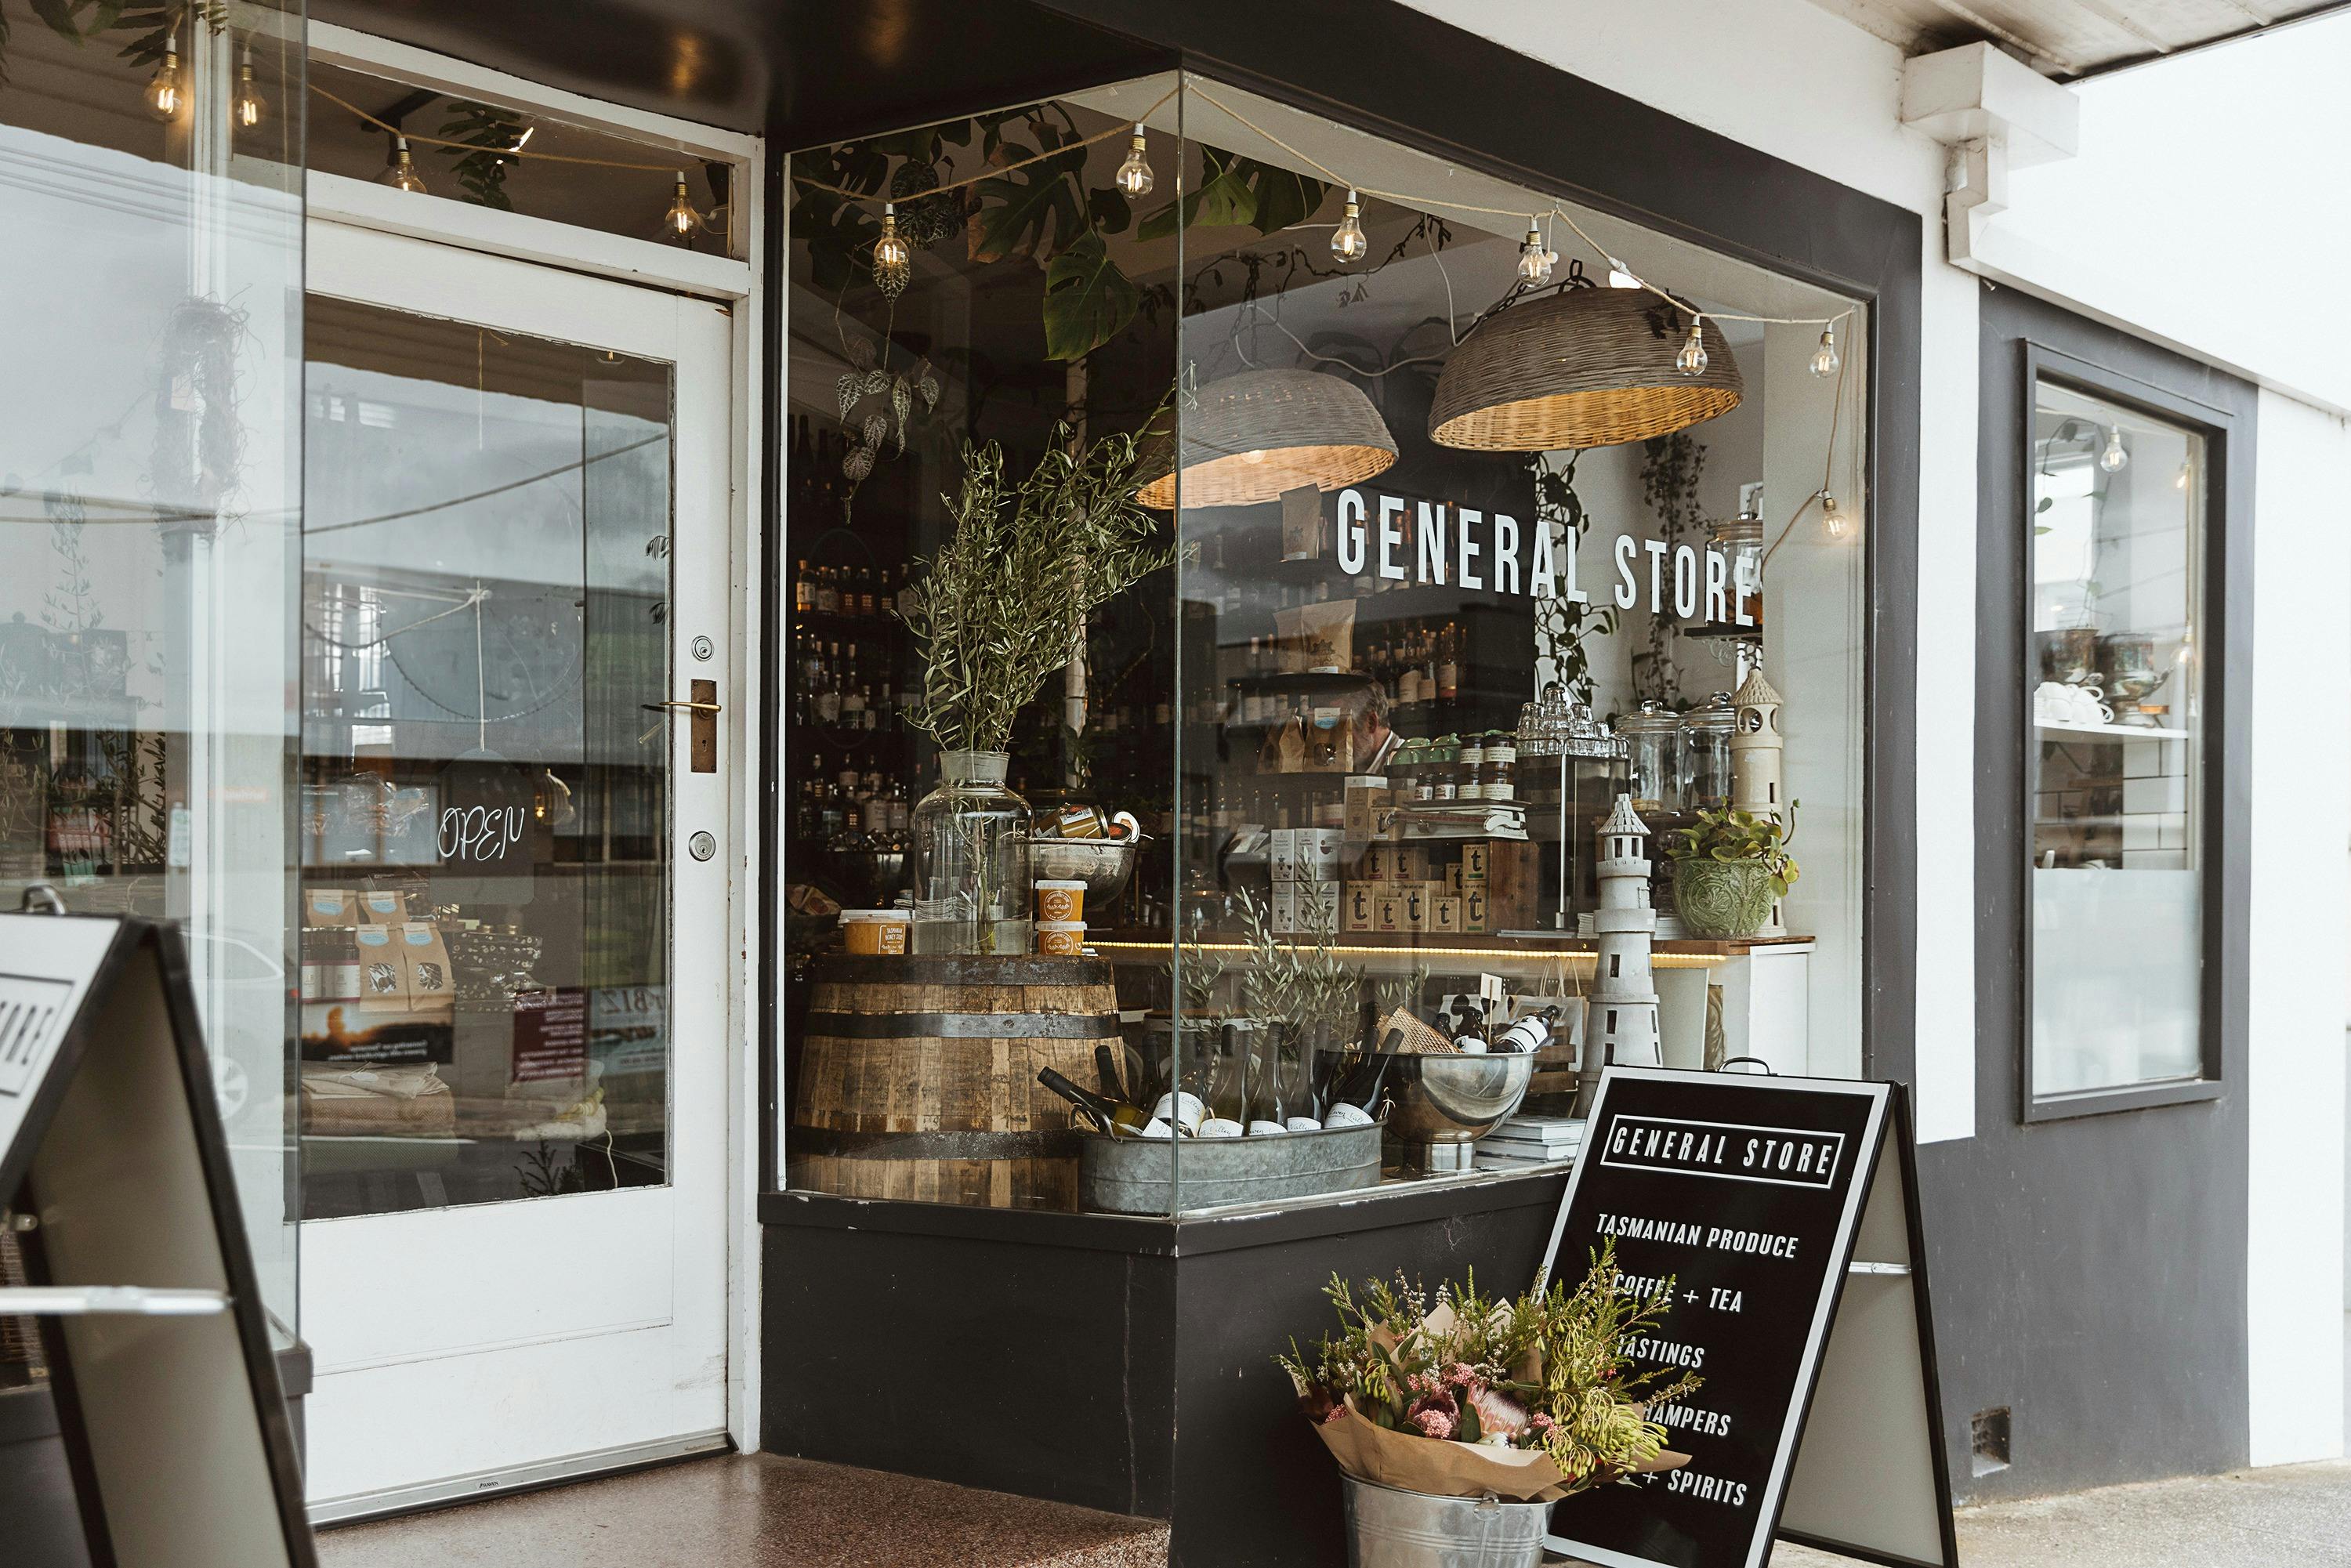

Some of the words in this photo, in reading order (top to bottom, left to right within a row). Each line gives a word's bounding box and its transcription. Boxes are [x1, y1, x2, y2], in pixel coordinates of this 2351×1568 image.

[1337, 488, 1588, 603] GENERAL
[1614, 534, 1755, 627] STORE
[437, 806, 525, 860] OPEN
[1612, 1127, 1726, 1164] GENERAL
[1743, 1139, 1832, 1174] STORE
[1596, 1213, 1702, 1245] TASMANIAN
[1706, 1227, 1799, 1258] PRODUCE
[1709, 1287, 1744, 1313] TEA
[1617, 1334, 1705, 1369] TASTINGS
[1643, 1403, 1731, 1436] HAMPERS
[1667, 1469, 1748, 1506] SPIRITS
